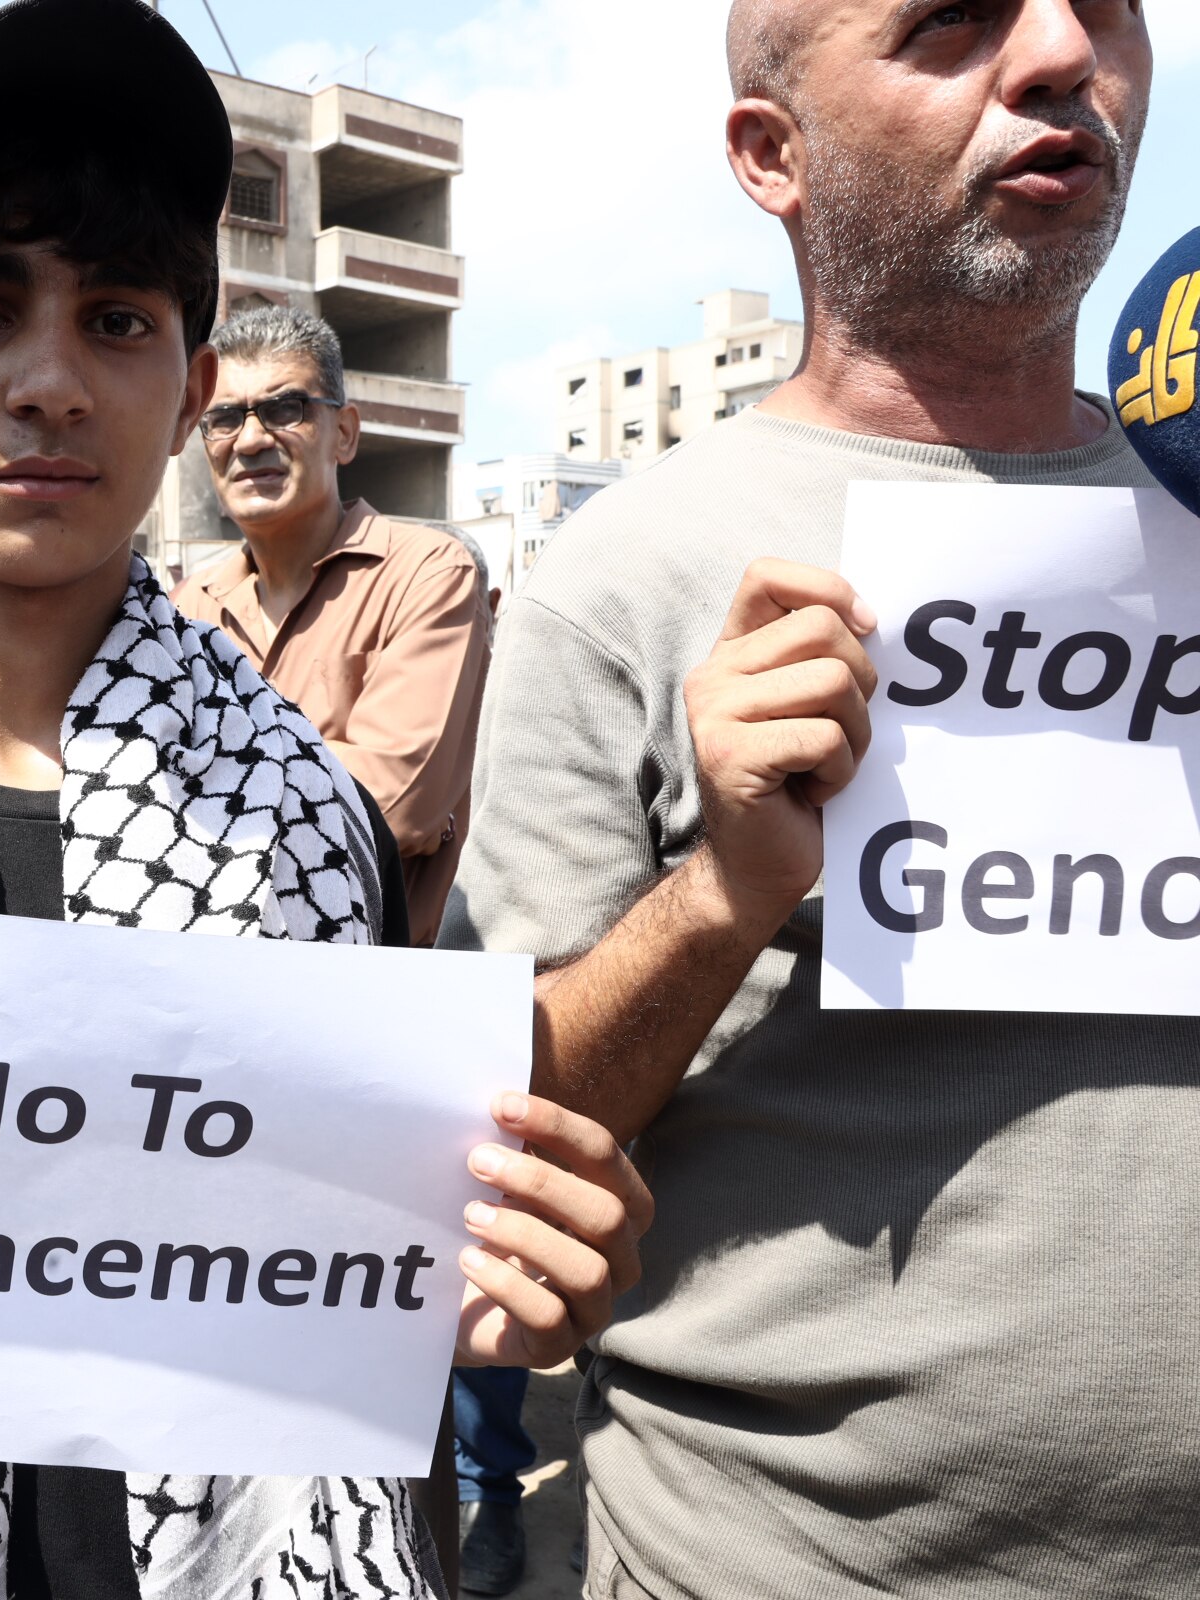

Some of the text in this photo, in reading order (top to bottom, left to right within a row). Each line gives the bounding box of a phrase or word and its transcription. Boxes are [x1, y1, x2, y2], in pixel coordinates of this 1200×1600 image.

[887, 600, 1200, 741] Stop
[859, 820, 1200, 940] Geno
[131, 1073, 254, 1158] To
